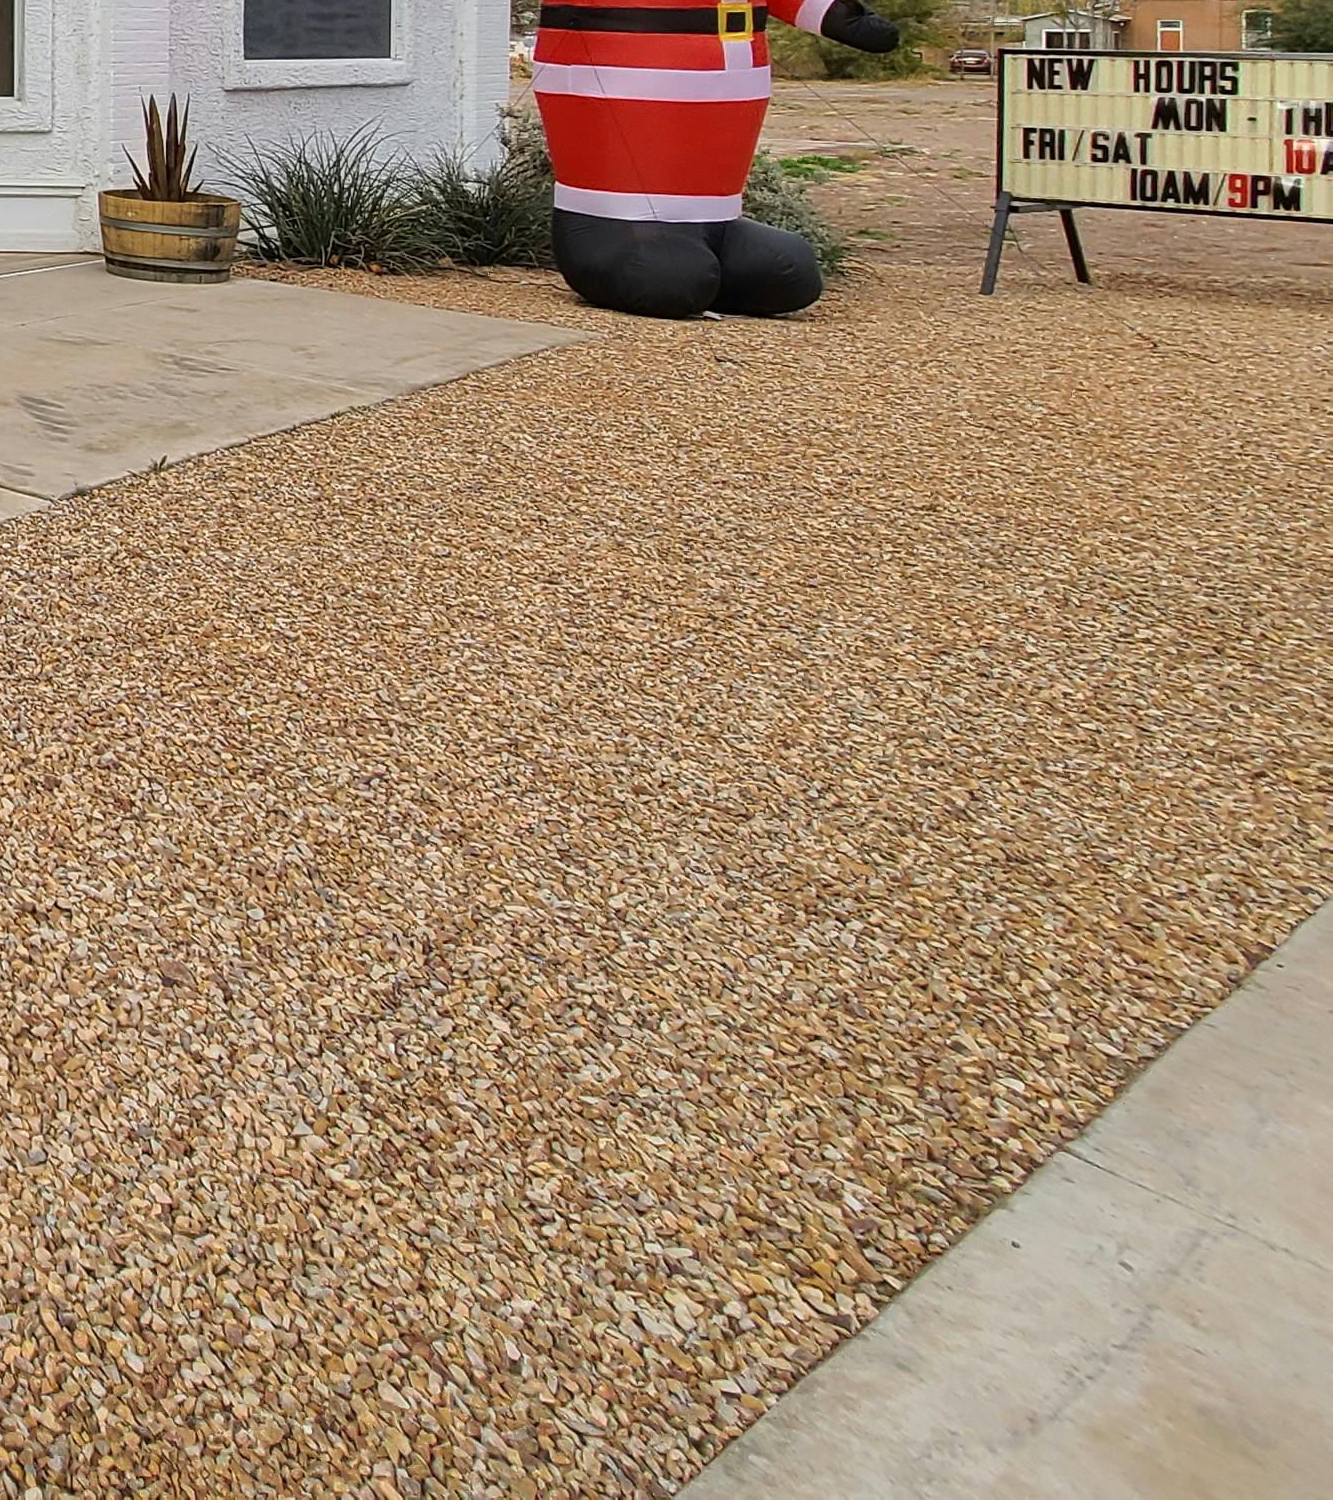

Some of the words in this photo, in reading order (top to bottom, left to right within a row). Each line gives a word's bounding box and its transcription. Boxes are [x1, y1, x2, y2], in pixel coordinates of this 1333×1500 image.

[1026, 58, 1095, 91] NEW
[1133, 60, 1238, 95] HOURS
[1152, 97, 1228, 131] MON
[1022, 128, 1153, 165] FRI/SAT
[1130, 168, 1302, 211] 10AM/9PM
